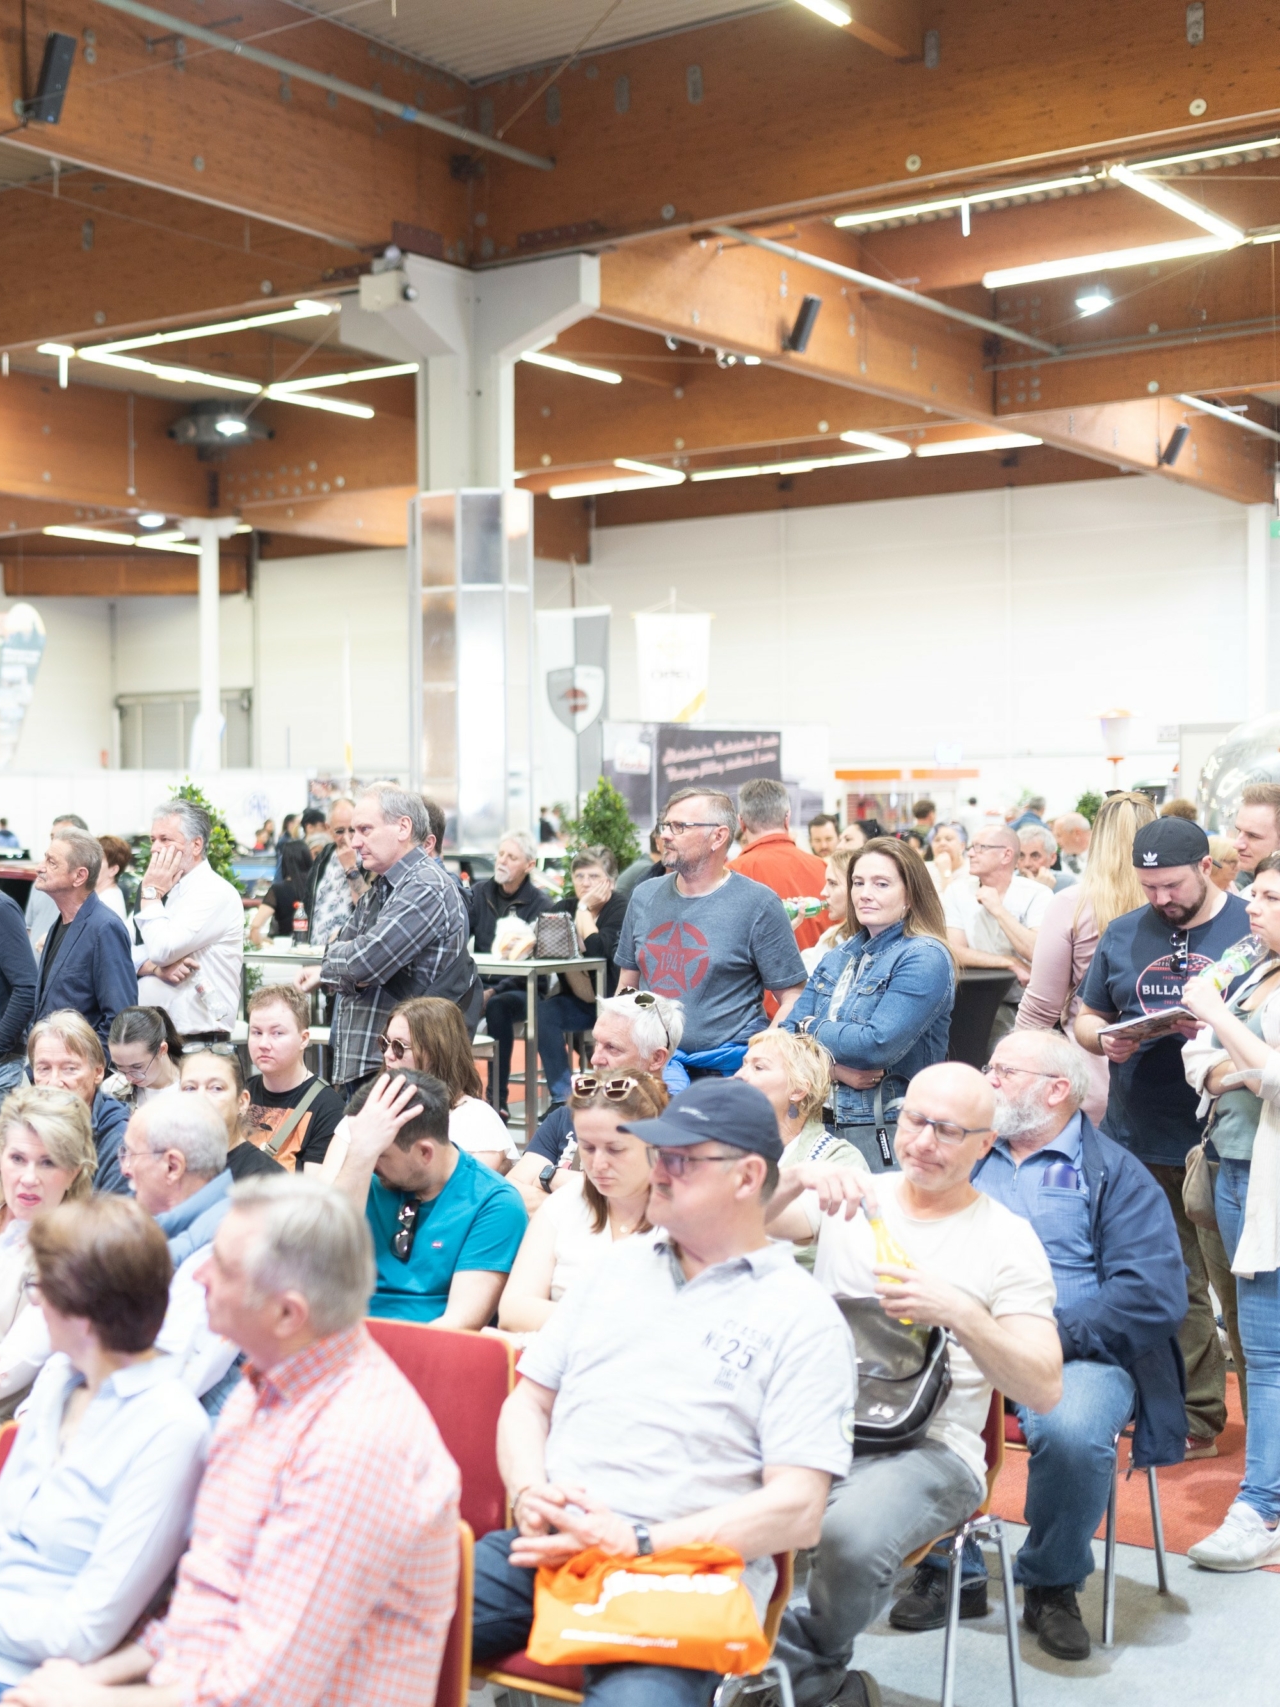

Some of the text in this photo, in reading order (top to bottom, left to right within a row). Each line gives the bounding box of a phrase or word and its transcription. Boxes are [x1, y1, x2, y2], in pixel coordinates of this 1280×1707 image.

[661, 952, 684, 972] 1941
[1142, 985, 1184, 996] BILLA
[720, 1339, 757, 1369] 25
